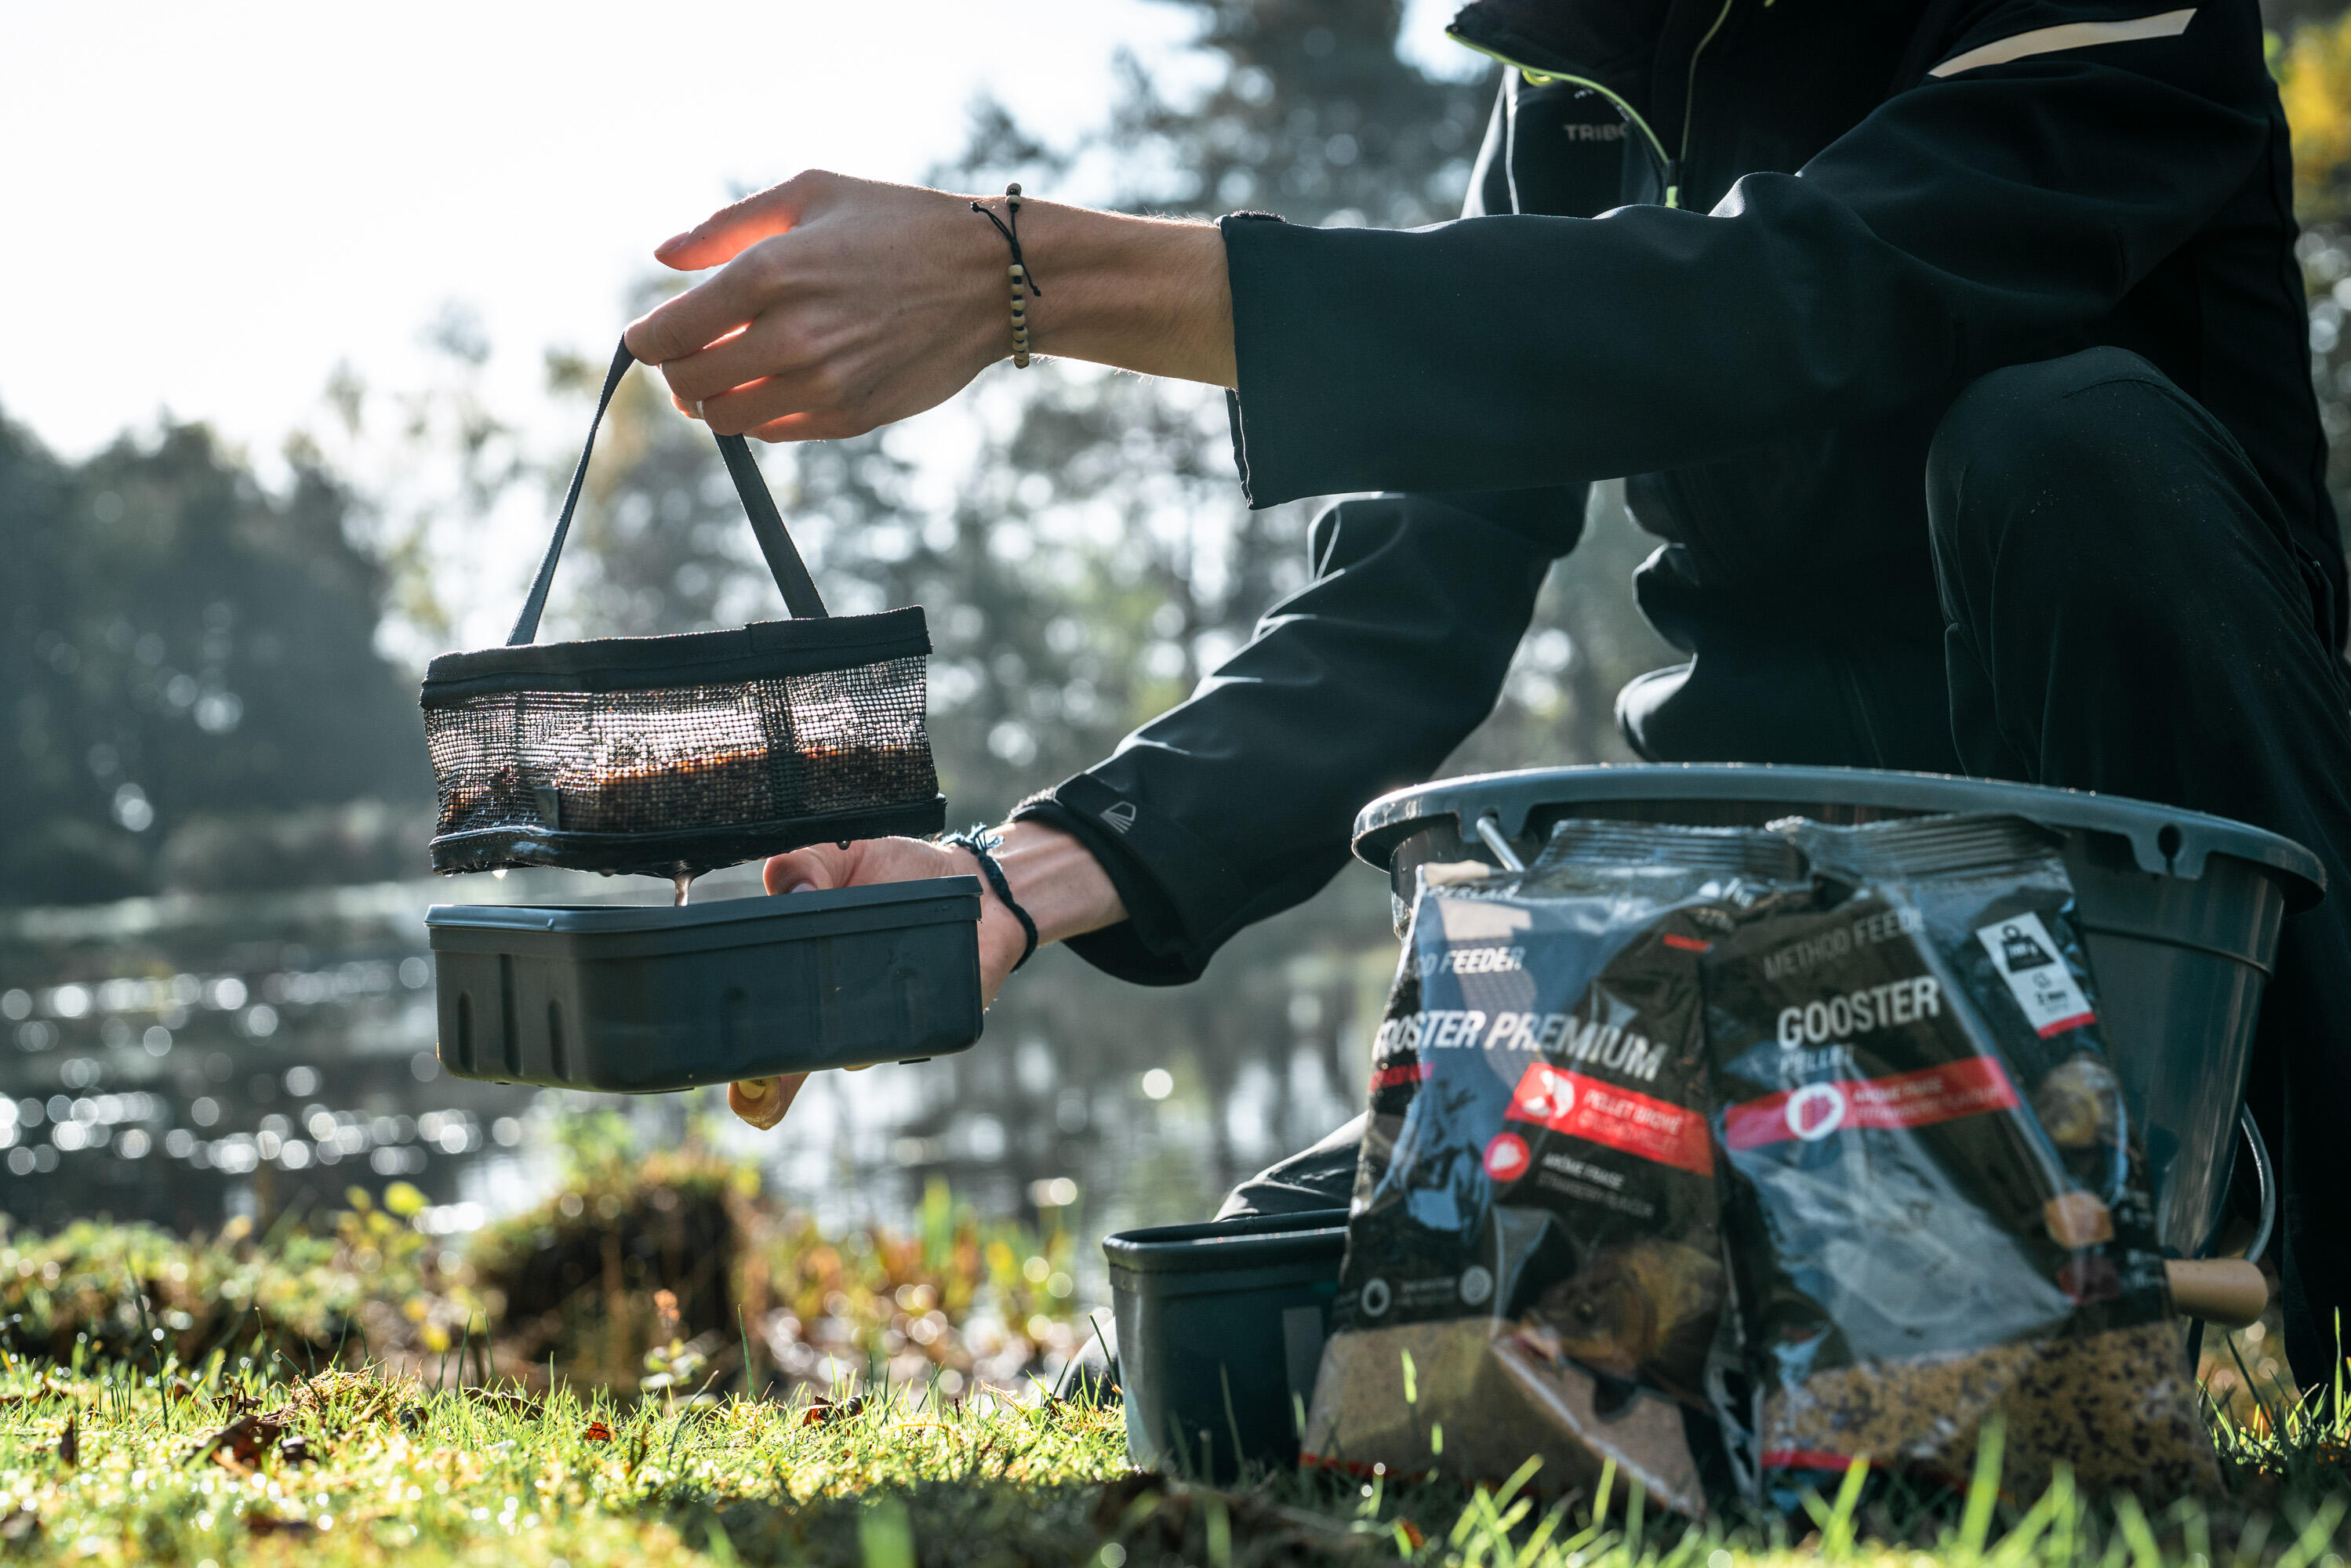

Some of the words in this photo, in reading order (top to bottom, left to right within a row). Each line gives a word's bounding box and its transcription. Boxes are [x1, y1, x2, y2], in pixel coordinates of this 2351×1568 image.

[1439, 946, 1526, 975] FEEDER
[1484, 1012, 1669, 1083] PREMIUM
[1776, 975, 1940, 1051] GOOSTER
